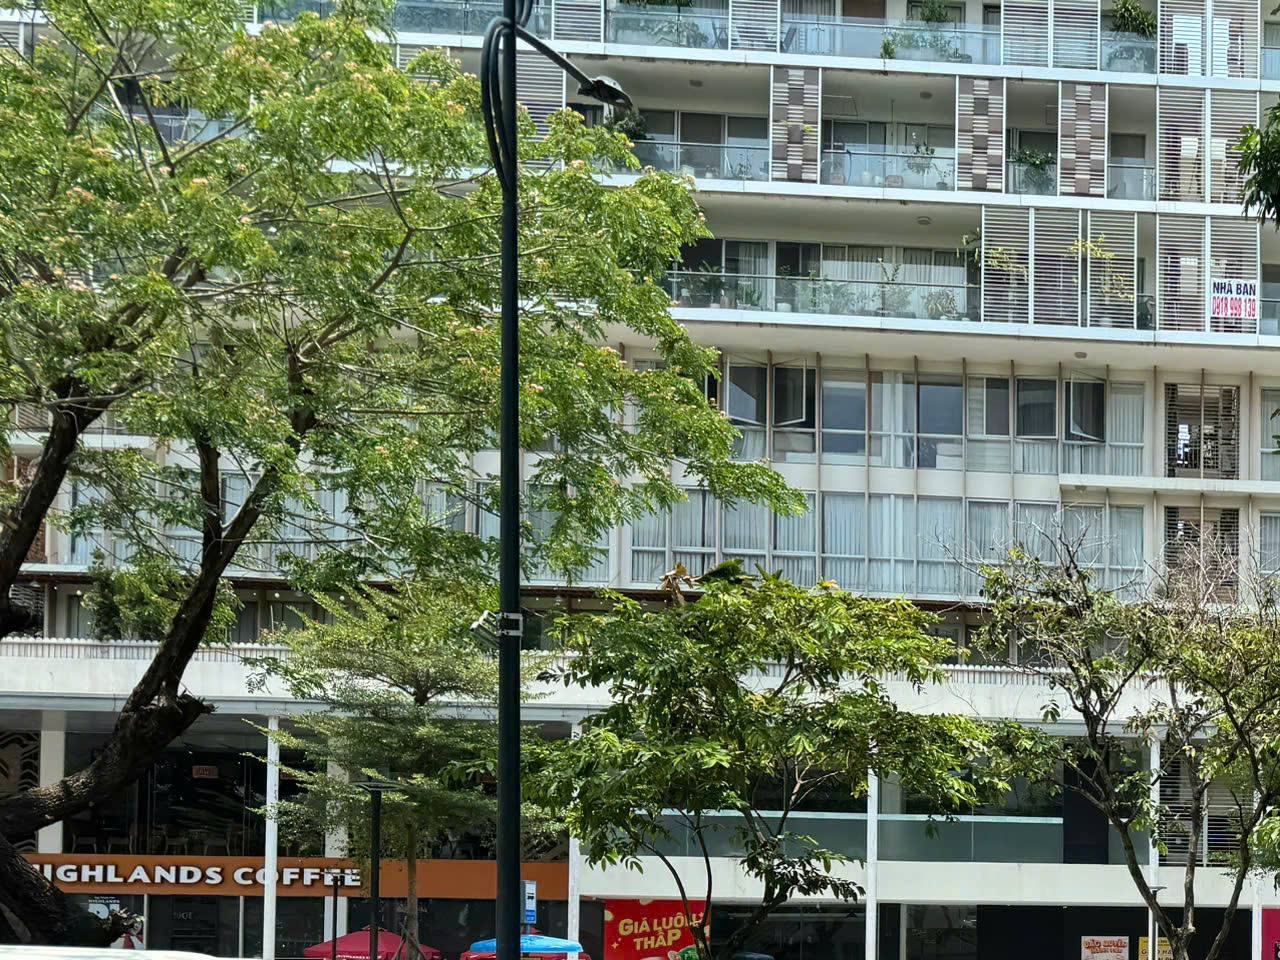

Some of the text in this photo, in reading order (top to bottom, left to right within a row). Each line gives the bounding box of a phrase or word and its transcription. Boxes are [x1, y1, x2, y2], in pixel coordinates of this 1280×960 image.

[1212, 296, 1229, 316] 0918
[1244, 298, 1256, 317] 139
[32, 863, 223, 886] IGHLANDS
[618, 917, 651, 937] GIÁ
[633, 927, 682, 951] THẤP
